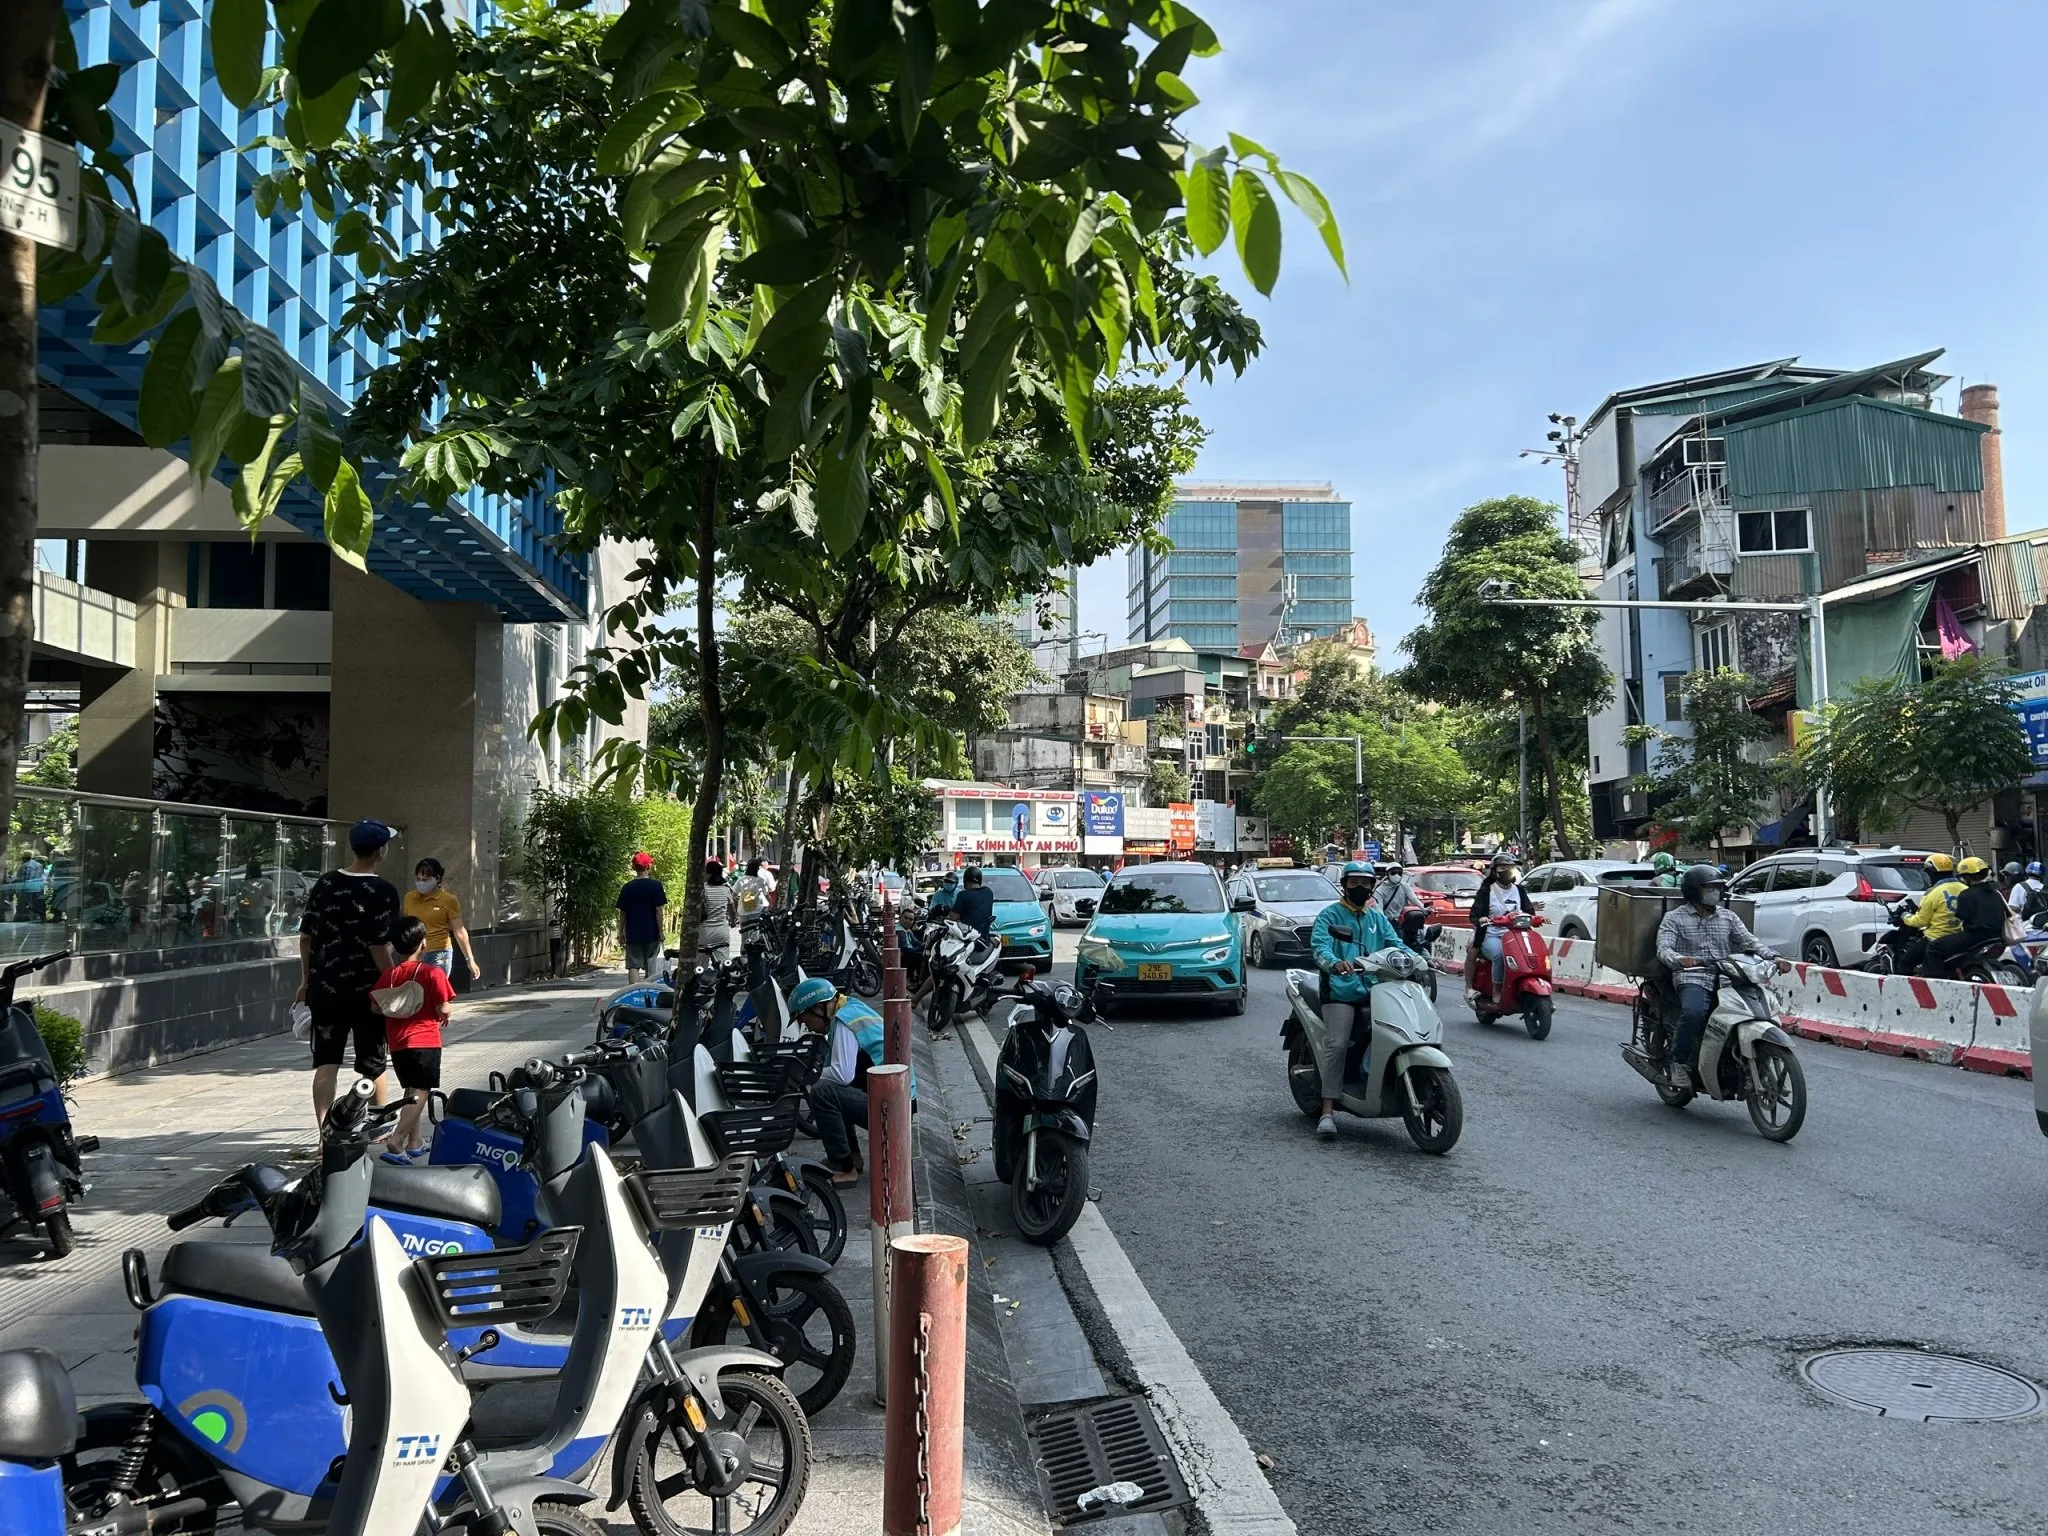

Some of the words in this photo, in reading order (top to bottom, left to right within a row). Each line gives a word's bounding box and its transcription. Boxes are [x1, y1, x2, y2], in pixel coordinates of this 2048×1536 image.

[2034, 675, 2045, 687] Oil
[1091, 803, 1118, 814] Dulux
[976, 837, 1006, 851] KÍNH
[1036, 840, 1052, 851] AN
[1055, 838, 1078, 851] PHÚ
[621, 1308, 651, 1325] TN
[396, 1434, 440, 1459] TN
